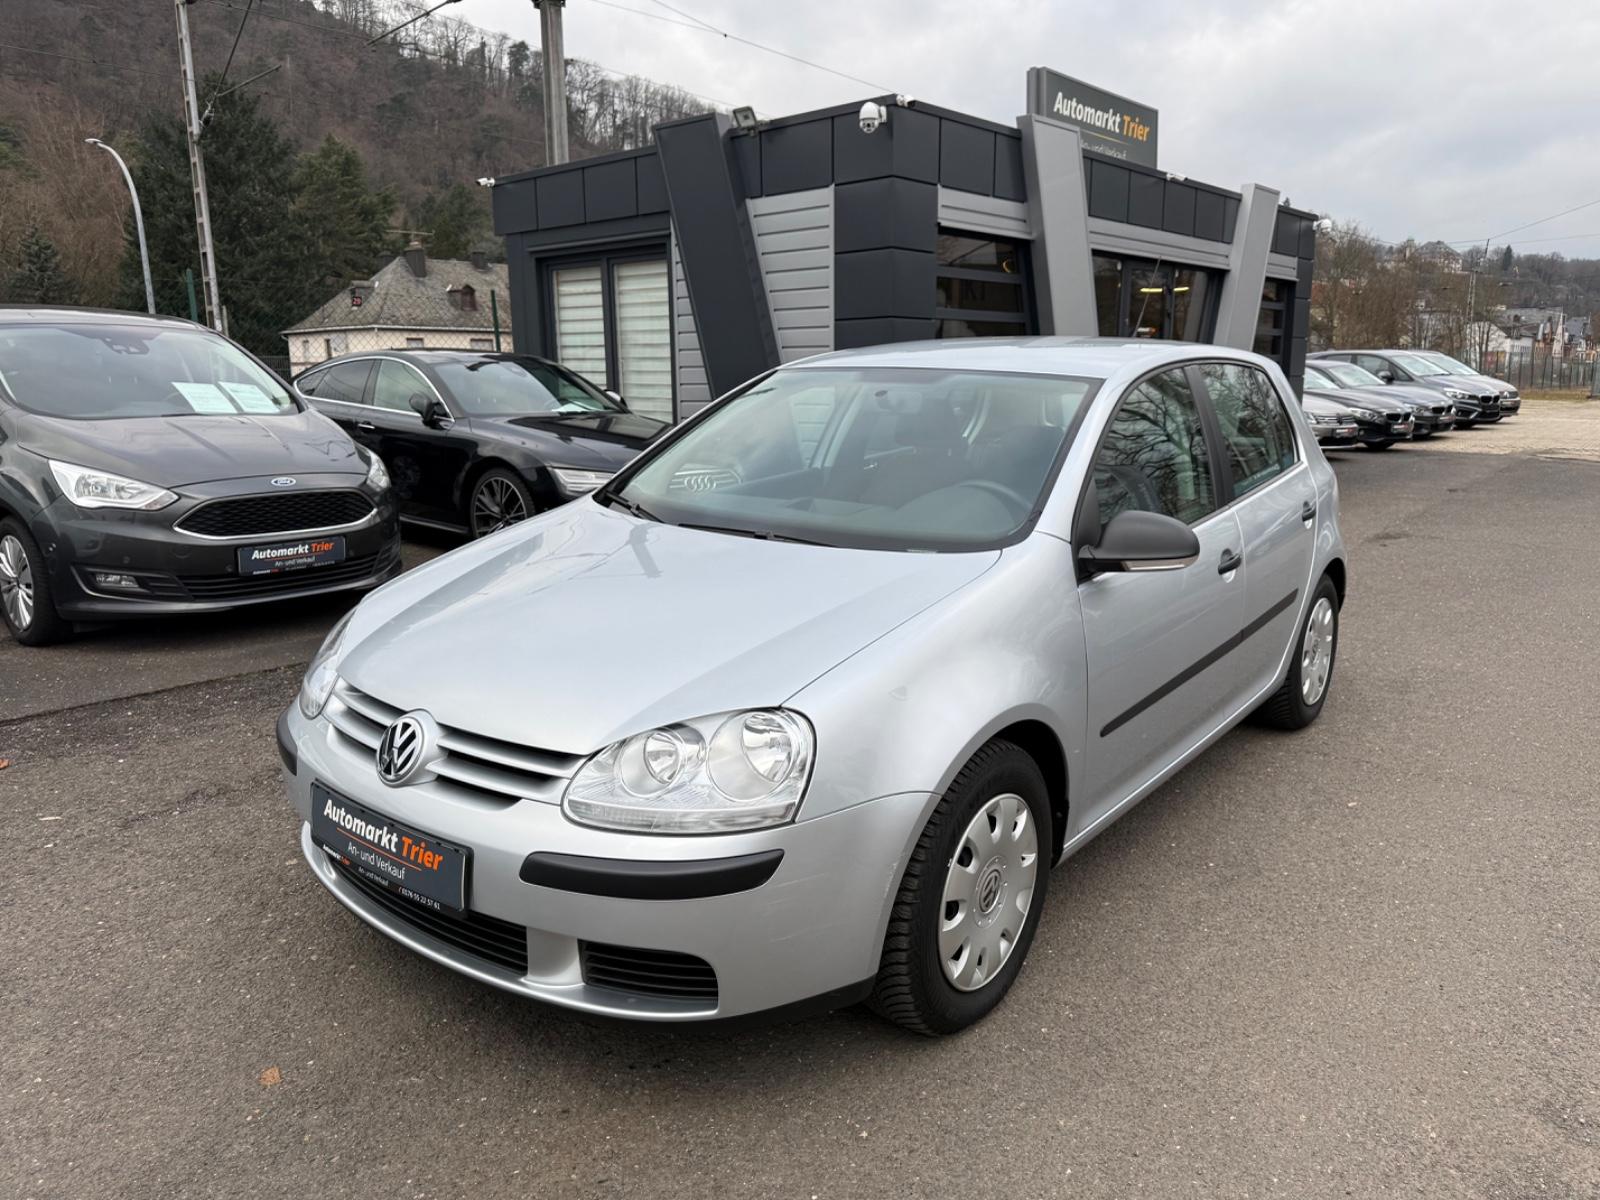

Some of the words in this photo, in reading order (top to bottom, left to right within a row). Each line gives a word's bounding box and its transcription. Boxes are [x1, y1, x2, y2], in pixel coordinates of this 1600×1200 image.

[1053, 91, 1120, 132] Automarkt
[1122, 115, 1149, 141] Trier
[251, 544, 309, 560] Automarkt
[311, 542, 335, 552] Trier
[324, 799, 398, 853] Automarkt
[402, 836, 443, 872] Trier
[348, 841, 360, 857] An-
[360, 851, 375, 865] und
[375, 856, 406, 880] Verkauf
